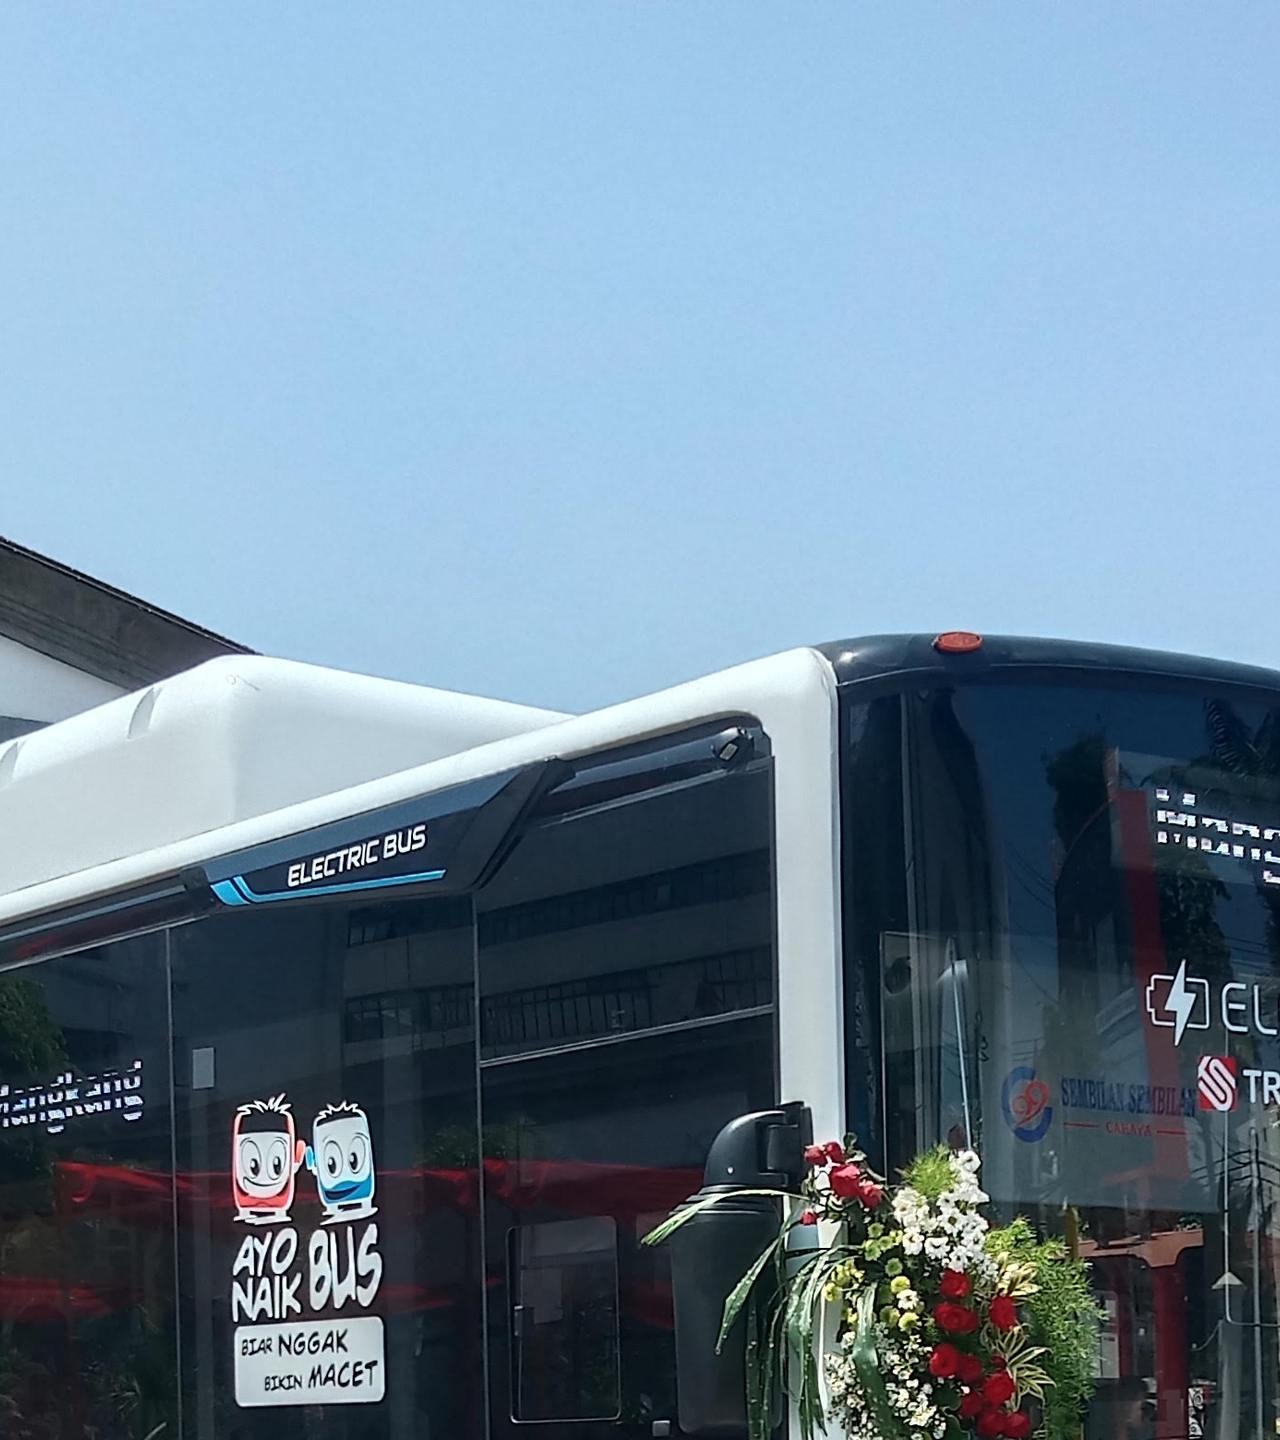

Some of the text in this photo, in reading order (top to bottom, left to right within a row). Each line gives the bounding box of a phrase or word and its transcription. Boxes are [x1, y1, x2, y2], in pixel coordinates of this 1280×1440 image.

[287, 824, 427, 888] ELECTRIC BUS
[232, 1227, 298, 1277] AYO
[232, 1223, 384, 1323] NAIK BUS
[241, 1328, 350, 1358] BIAR NGGAK
[264, 1360, 379, 1392] BIKIN MACET
